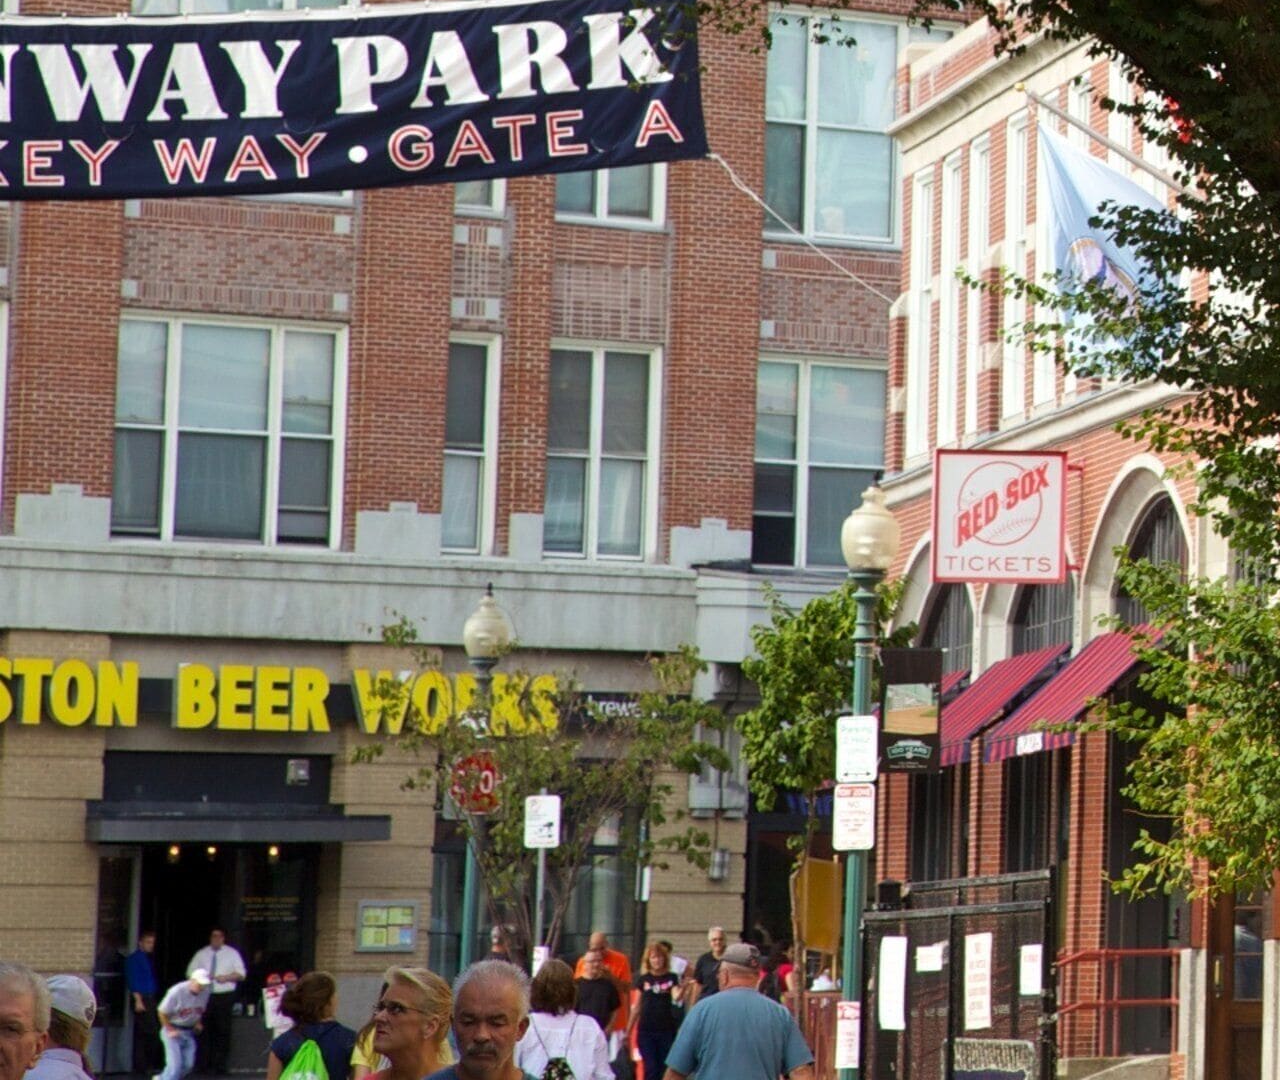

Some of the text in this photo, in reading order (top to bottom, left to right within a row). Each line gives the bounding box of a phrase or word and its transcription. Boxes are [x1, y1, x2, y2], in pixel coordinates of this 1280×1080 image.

[0, 8, 674, 123] WAY PARK
[0, 99, 685, 187] EY WAY GATE A
[954, 461, 1049, 548] RED SOX
[944, 556, 1052, 573] TICKETS
[174, 662, 331, 732] BEER
